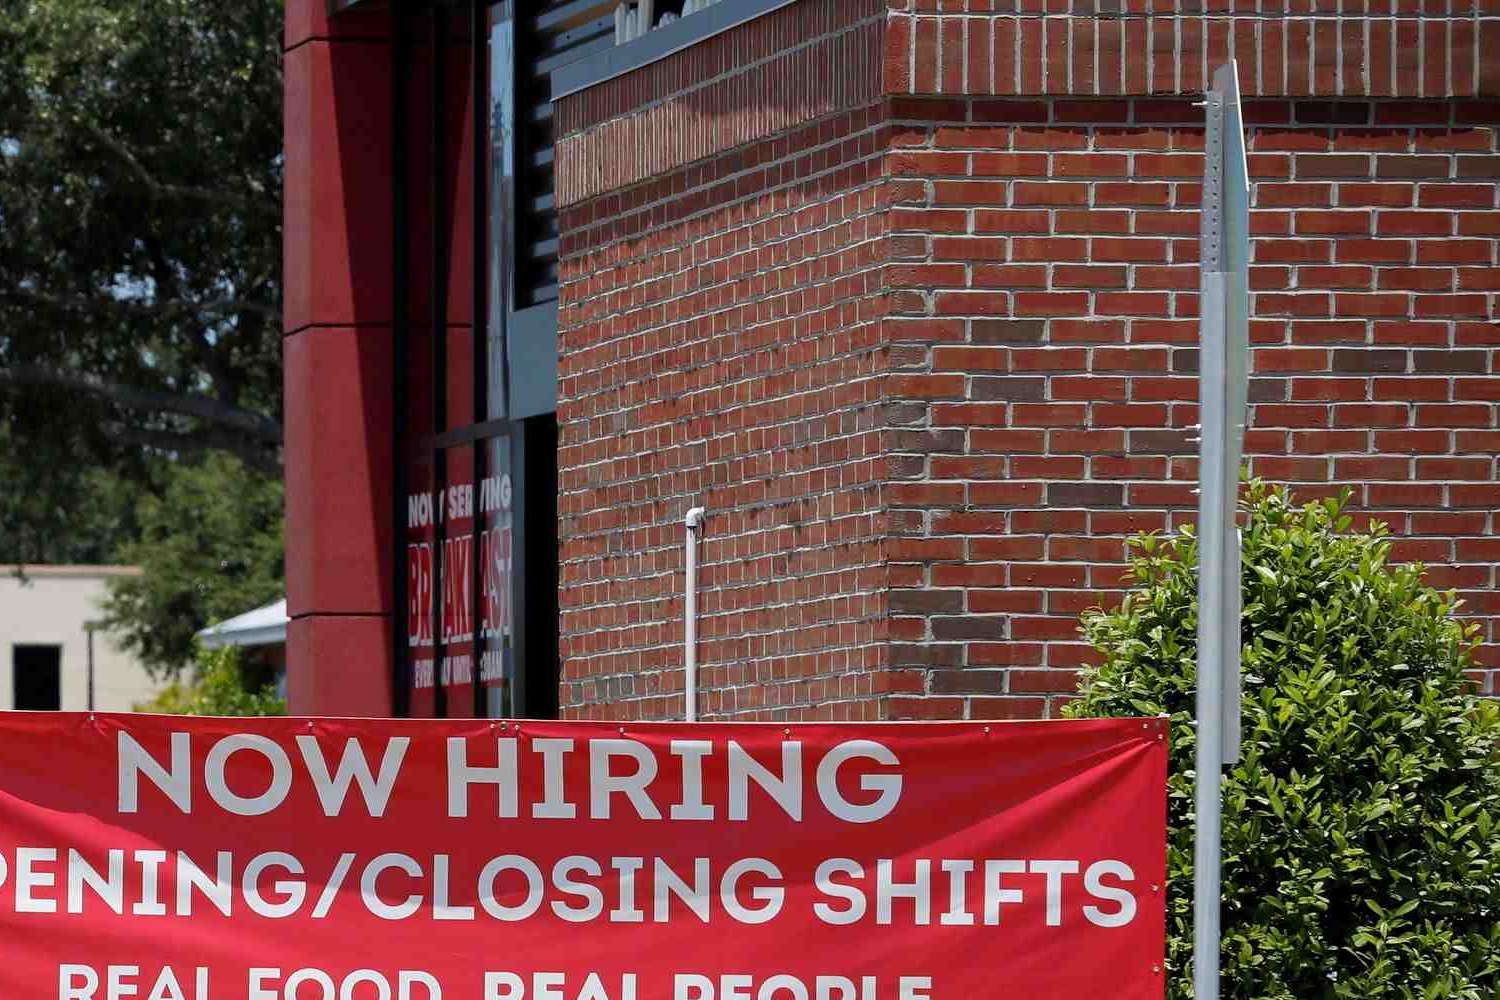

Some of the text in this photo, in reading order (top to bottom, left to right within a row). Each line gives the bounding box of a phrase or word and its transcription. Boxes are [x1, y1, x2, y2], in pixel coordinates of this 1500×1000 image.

[117, 729, 903, 823] NOW HIRING
[813, 858, 1137, 928] SHIFTS
